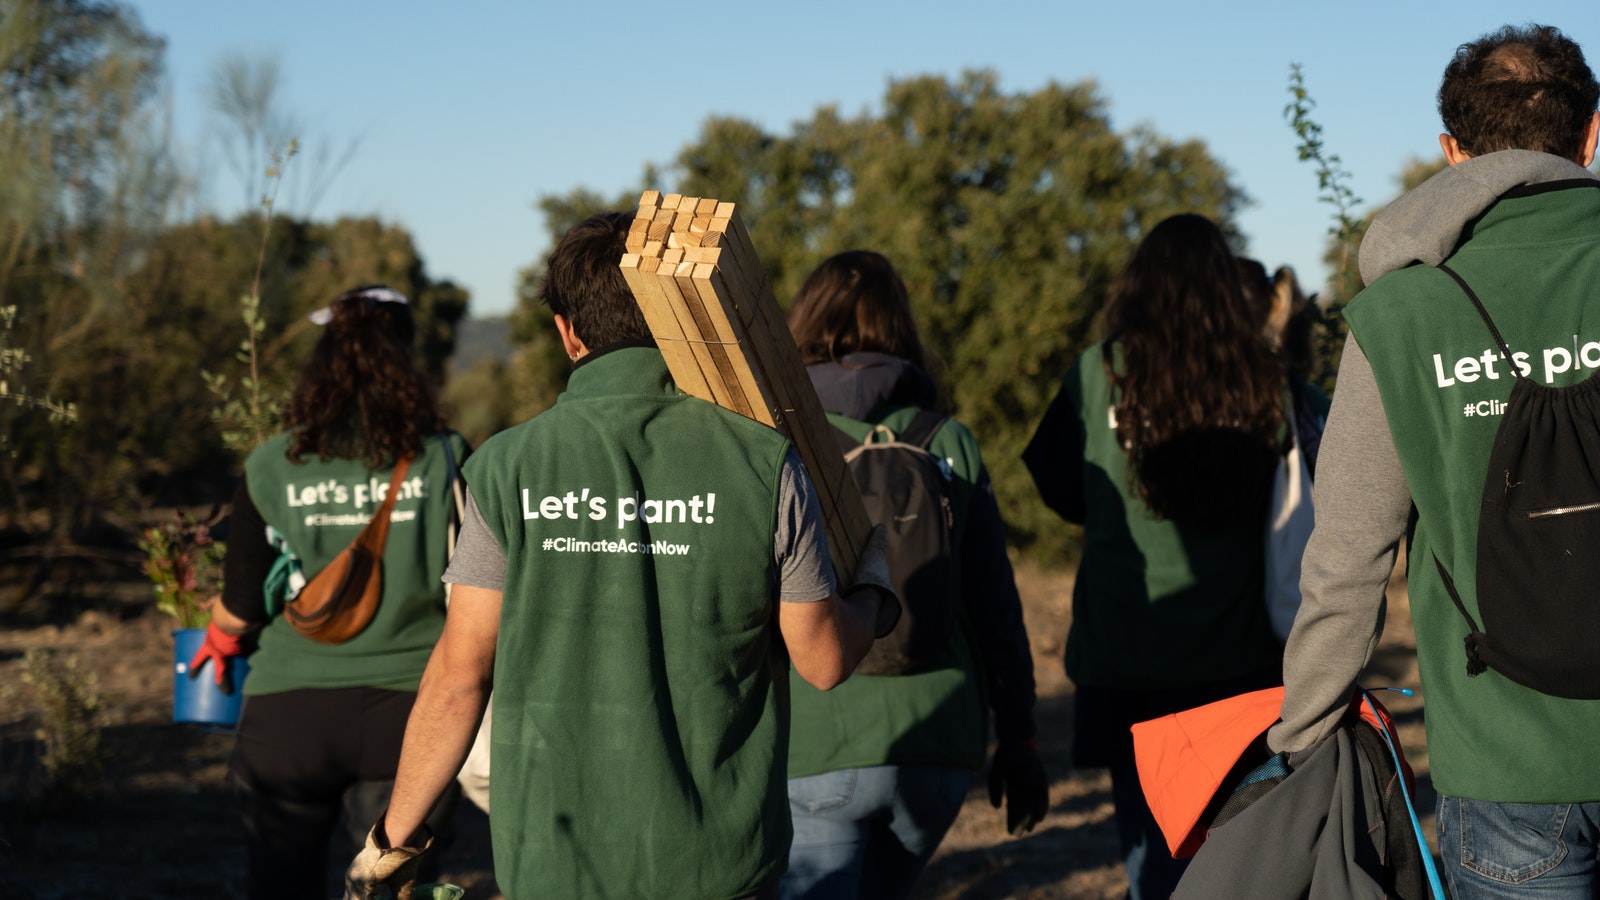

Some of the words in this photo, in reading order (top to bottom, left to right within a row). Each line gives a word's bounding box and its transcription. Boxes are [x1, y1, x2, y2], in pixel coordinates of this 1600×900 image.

[287, 479, 349, 507] Let's
[522, 488, 607, 520] Let's
[618, 490, 716, 529] pant!
